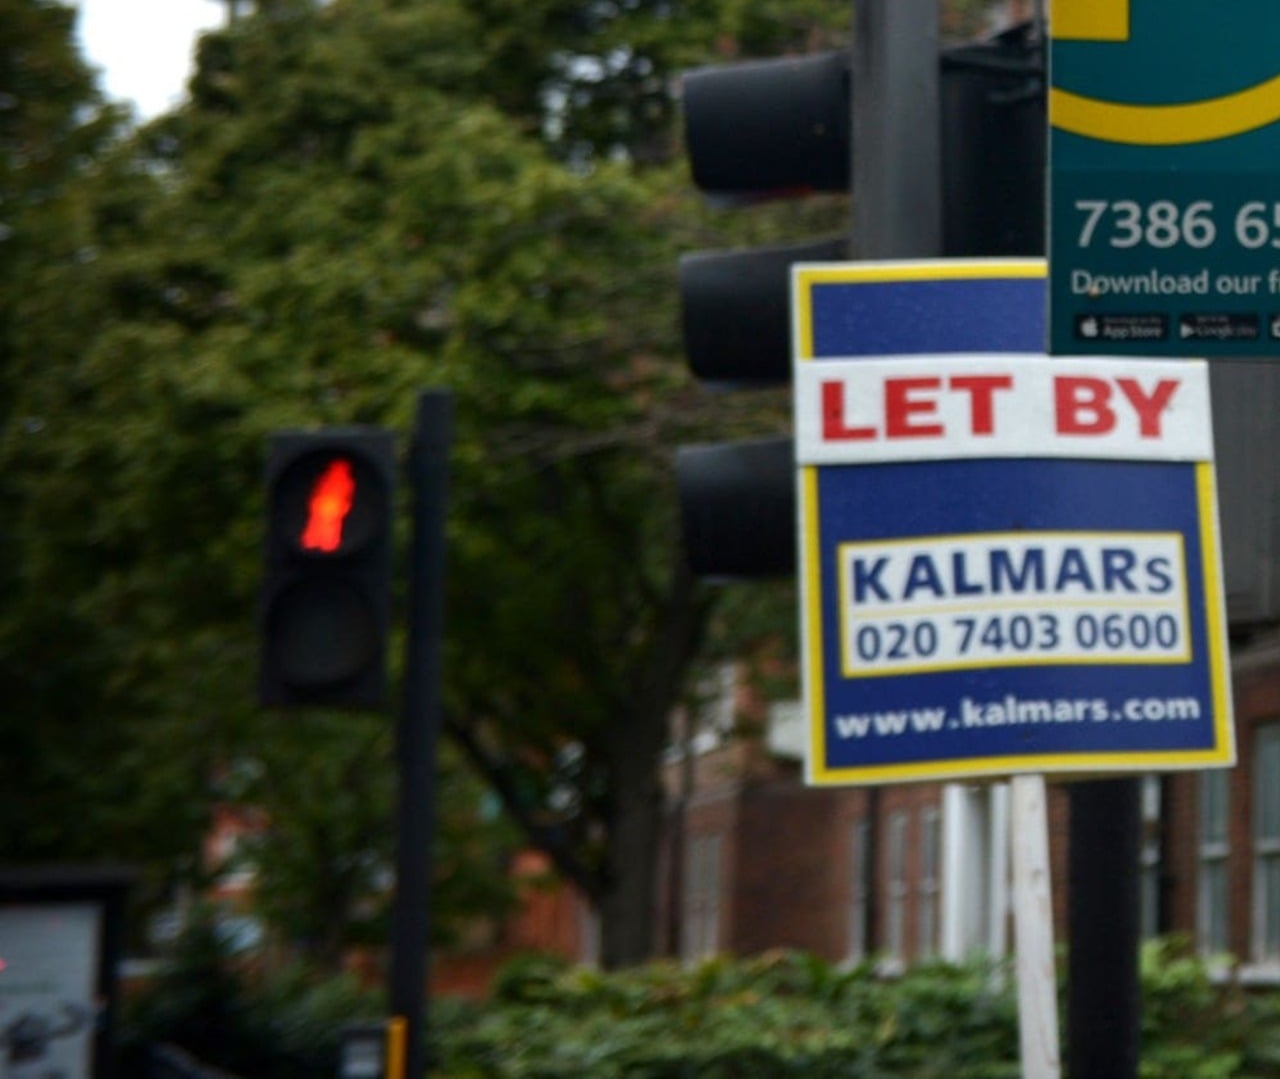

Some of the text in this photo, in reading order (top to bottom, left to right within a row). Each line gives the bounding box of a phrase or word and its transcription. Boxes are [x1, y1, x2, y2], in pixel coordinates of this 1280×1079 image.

[1074, 200, 1216, 248] 7386
[1071, 268, 1209, 296] Download
[1216, 274, 1261, 295] our
[819, 374, 1181, 443] LET BY
[856, 613, 1177, 662] 020 7403 0600
[835, 695, 1200, 739] www.kalmars.com
